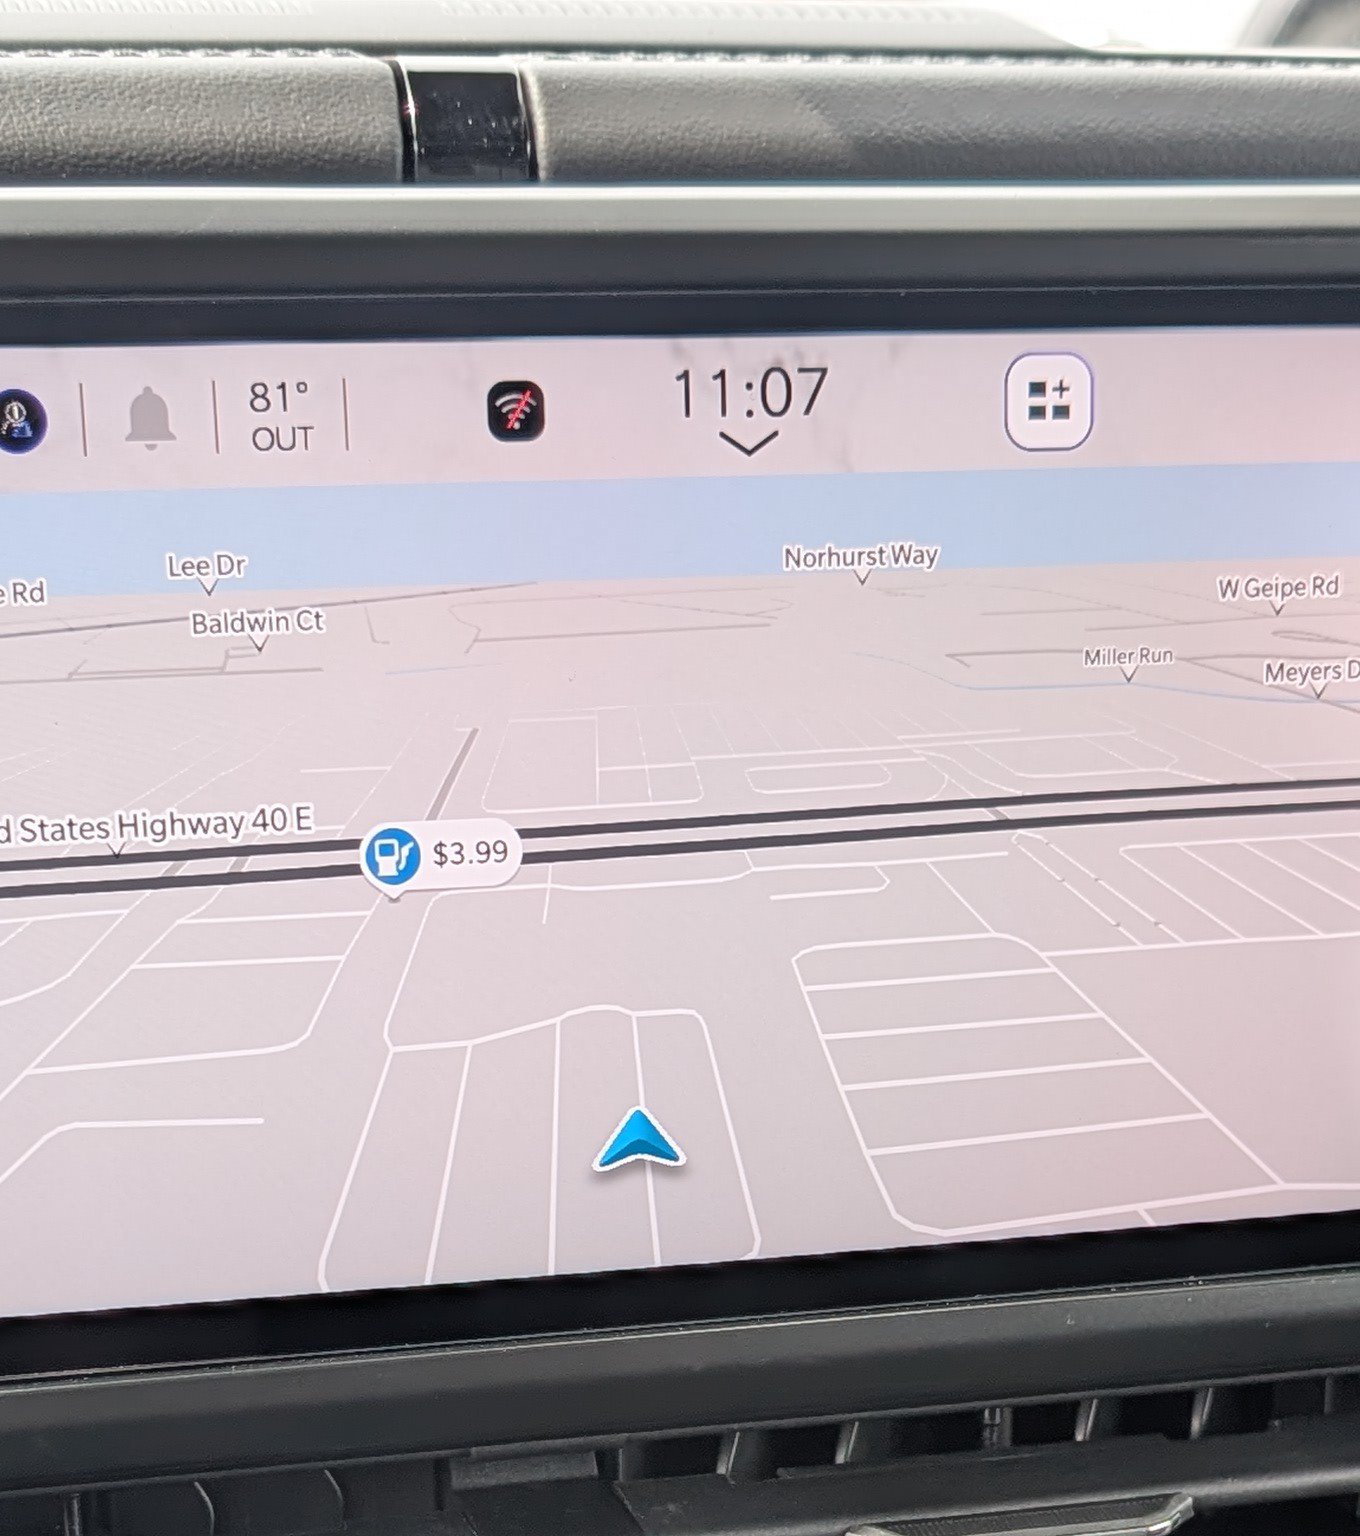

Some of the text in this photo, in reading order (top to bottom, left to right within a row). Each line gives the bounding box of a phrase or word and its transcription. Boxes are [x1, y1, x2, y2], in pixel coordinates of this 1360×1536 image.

[248, 381, 309, 413] 81°
[675, 367, 828, 419] 11:07
[251, 425, 314, 452] OUT
[168, 556, 246, 578] Lee Dr
[784, 544, 938, 570] Norhurst Way
[13, 581, 45, 603] Rd
[1219, 575, 1339, 603] W Geipe Rd
[192, 610, 324, 636] Baldwin Ct
[1084, 646, 1173, 667] Miller Run
[1265, 661, 1340, 686] Meyers
[19, 815, 111, 843] States
[118, 810, 245, 843] Highway
[252, 808, 288, 832] 40
[296, 807, 312, 831] E
[433, 840, 509, 867] $3.99
